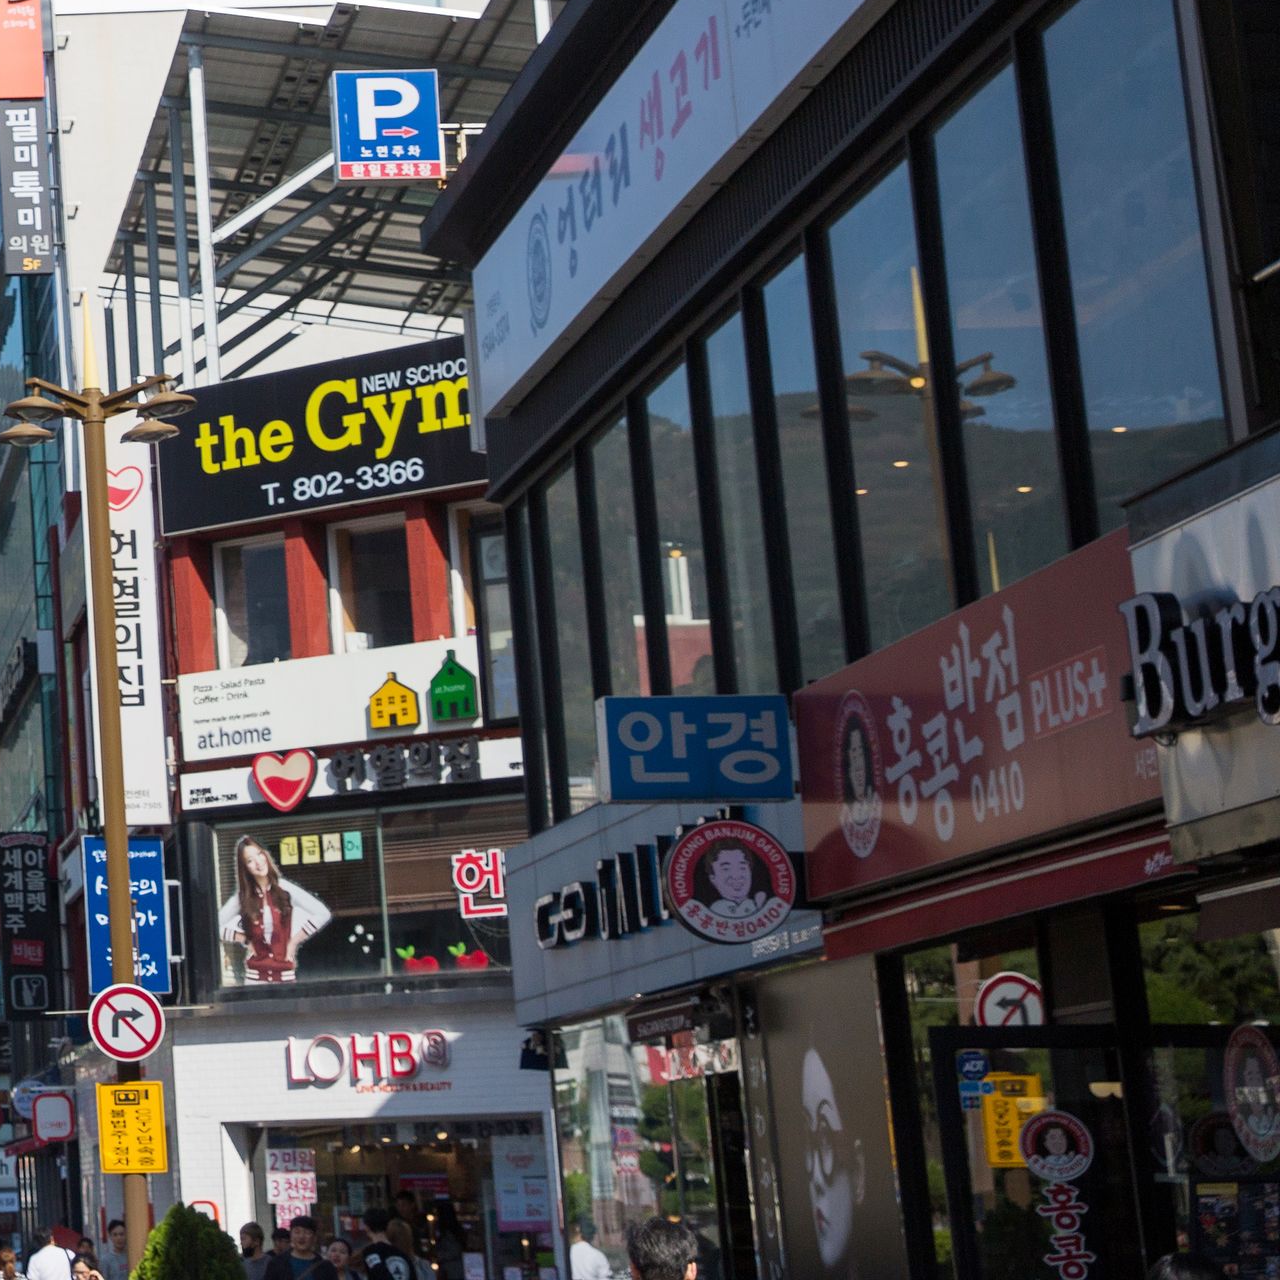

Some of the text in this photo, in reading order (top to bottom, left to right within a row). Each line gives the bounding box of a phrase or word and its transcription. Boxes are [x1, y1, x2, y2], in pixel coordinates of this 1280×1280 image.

[356, 77, 420, 140] P
[640, 15, 721, 181] 생고기
[4, 107, 44, 230] 필미톡미
[9, 235, 50, 256] 의원
[22, 257, 42, 271] 5F
[361, 371, 401, 393] NEW
[195, 378, 471, 474] the Gym
[260, 457, 424, 505] T. 802-3366
[198, 727, 271, 749] at.home
[618, 710, 781, 784] 안경
[885, 604, 1024, 841] 홍콩반점
[971, 762, 1024, 821] 0410
[2, 849, 27, 935] 세계맥주
[672, 835, 705, 898] HONGKONG
[704, 827, 756, 842] BANJUM
[777, 862, 790, 896] PLUS
